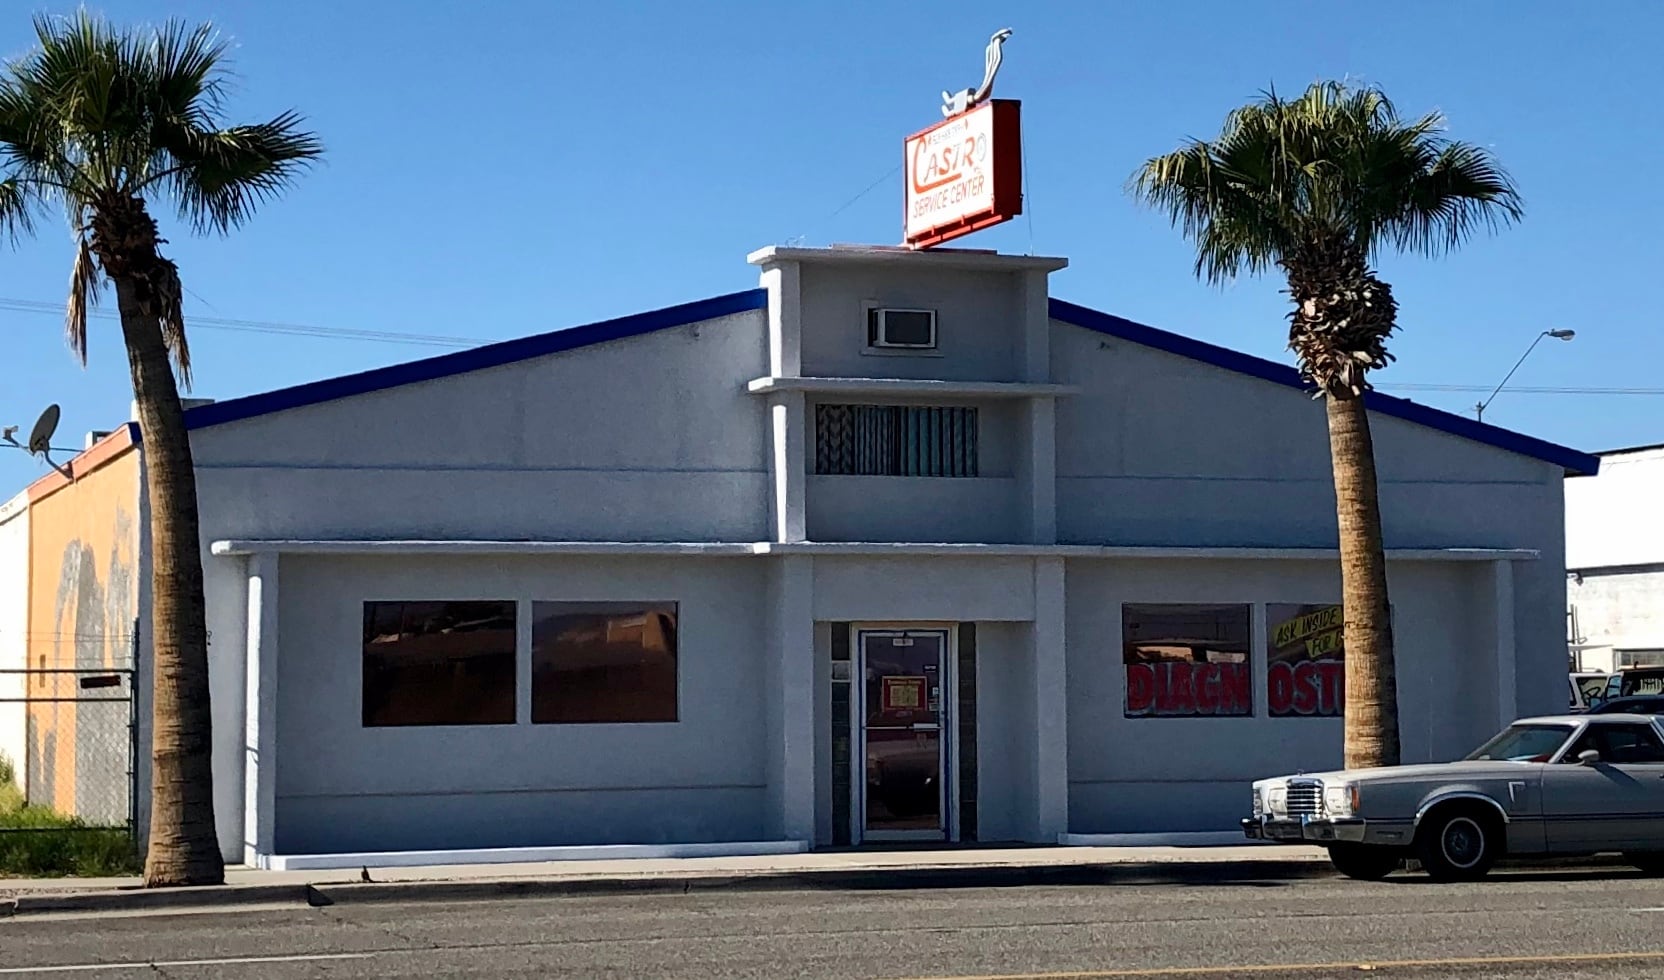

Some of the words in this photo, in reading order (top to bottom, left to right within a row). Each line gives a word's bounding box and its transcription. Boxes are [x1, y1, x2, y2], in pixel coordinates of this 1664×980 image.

[912, 132, 987, 195] CASTRO
[912, 188, 949, 218] SERVICE
[950, 174, 985, 204] CENTER
[1275, 623, 1297, 645] ASK
[1302, 608, 1337, 634] INSIDE
[1312, 635, 1331, 655] FOR
